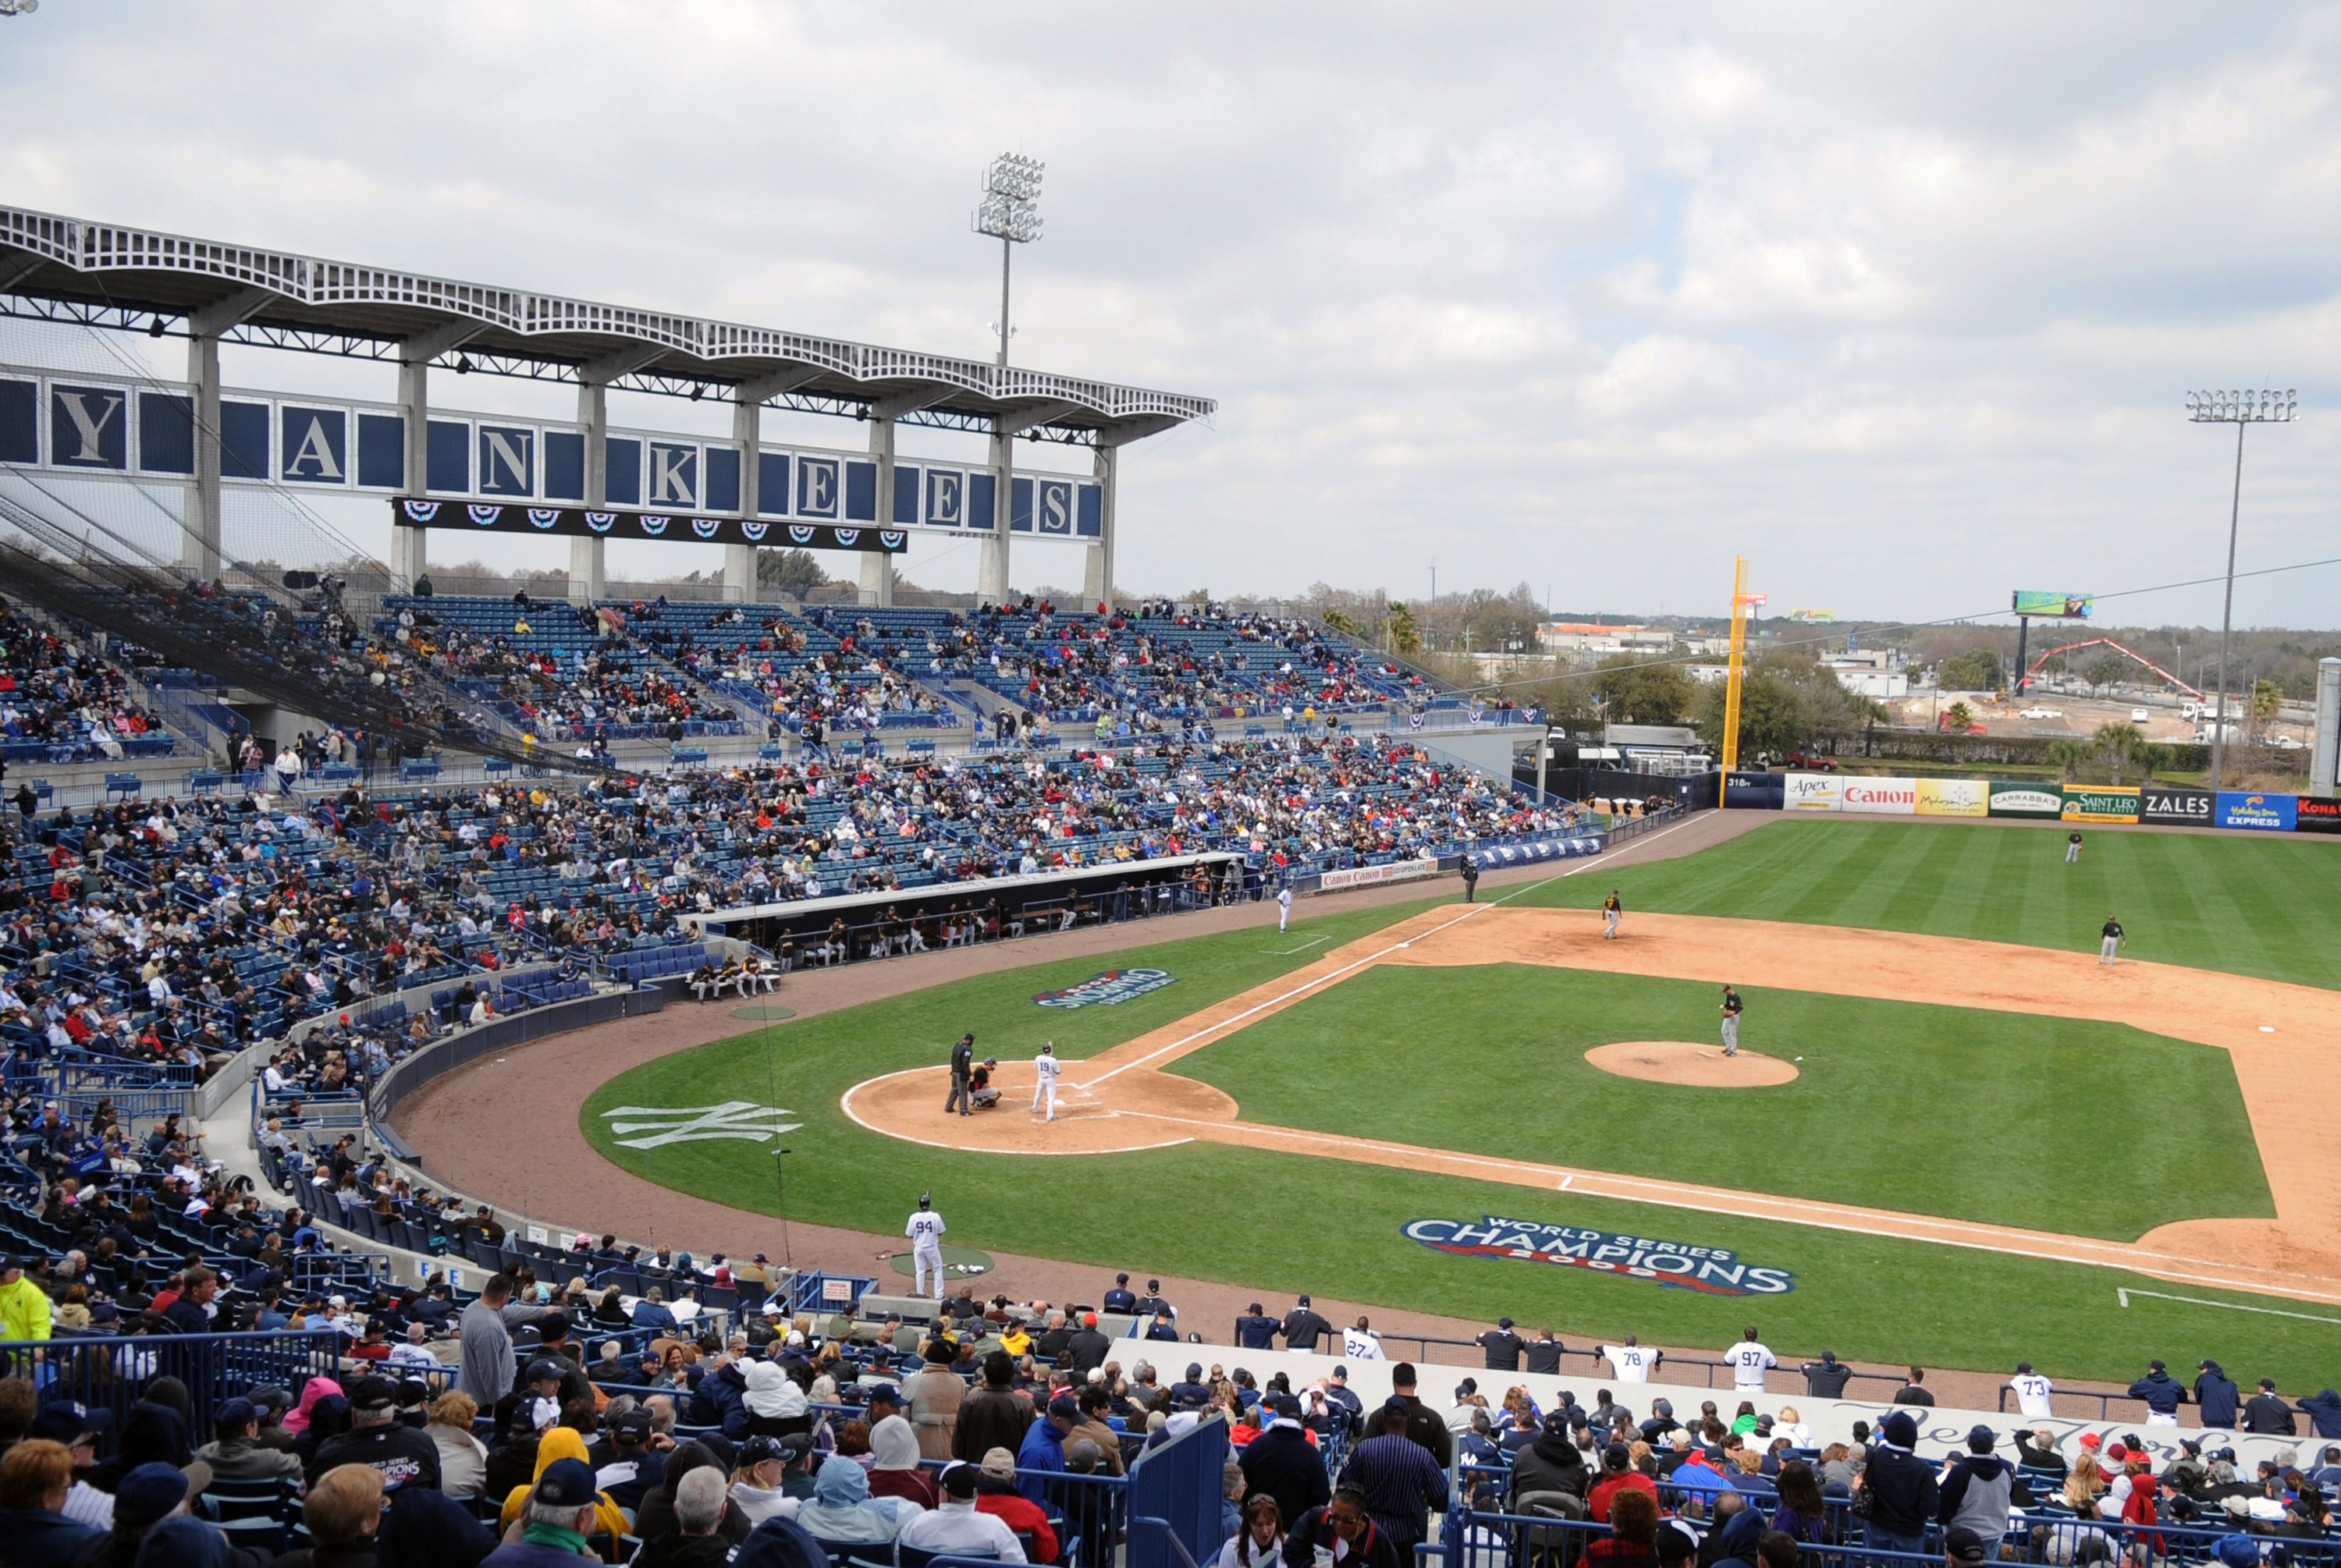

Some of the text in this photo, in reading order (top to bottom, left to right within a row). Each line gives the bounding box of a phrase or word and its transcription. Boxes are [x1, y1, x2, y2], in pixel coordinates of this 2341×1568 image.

[54, 391, 1067, 530] YANKEES
[1789, 779, 1828, 796] Apex
[1845, 787, 1915, 804] Canon
[1994, 793, 2057, 806] CARRABBA'S
[2079, 793, 2137, 809] SAINT LEO
[2146, 796, 2209, 813] ZALES
[2230, 805, 2261, 817] Holiday
[2227, 817, 2280, 826] EXPRESS
[1324, 874, 1351, 885] Canon
[1353, 870, 1380, 882] Canon
[1039, 1062, 1050, 1072] 19
[916, 1221, 932, 1233] 94
[1489, 1217, 1731, 1261] WORLD SERIES
[1406, 1219, 1791, 1293] CHAMPIONS
[1509, 1250, 1657, 1276] 2009
[421, 1262, 429, 1276] F
[449, 1269, 459, 1286] E
[1347, 1339, 1366, 1358] 27
[1624, 1352, 1642, 1366] 78
[1742, 1351, 1761, 1367] 97
[2023, 1381, 2045, 1396] 73
[388, 1456, 409, 1466] SERIES
